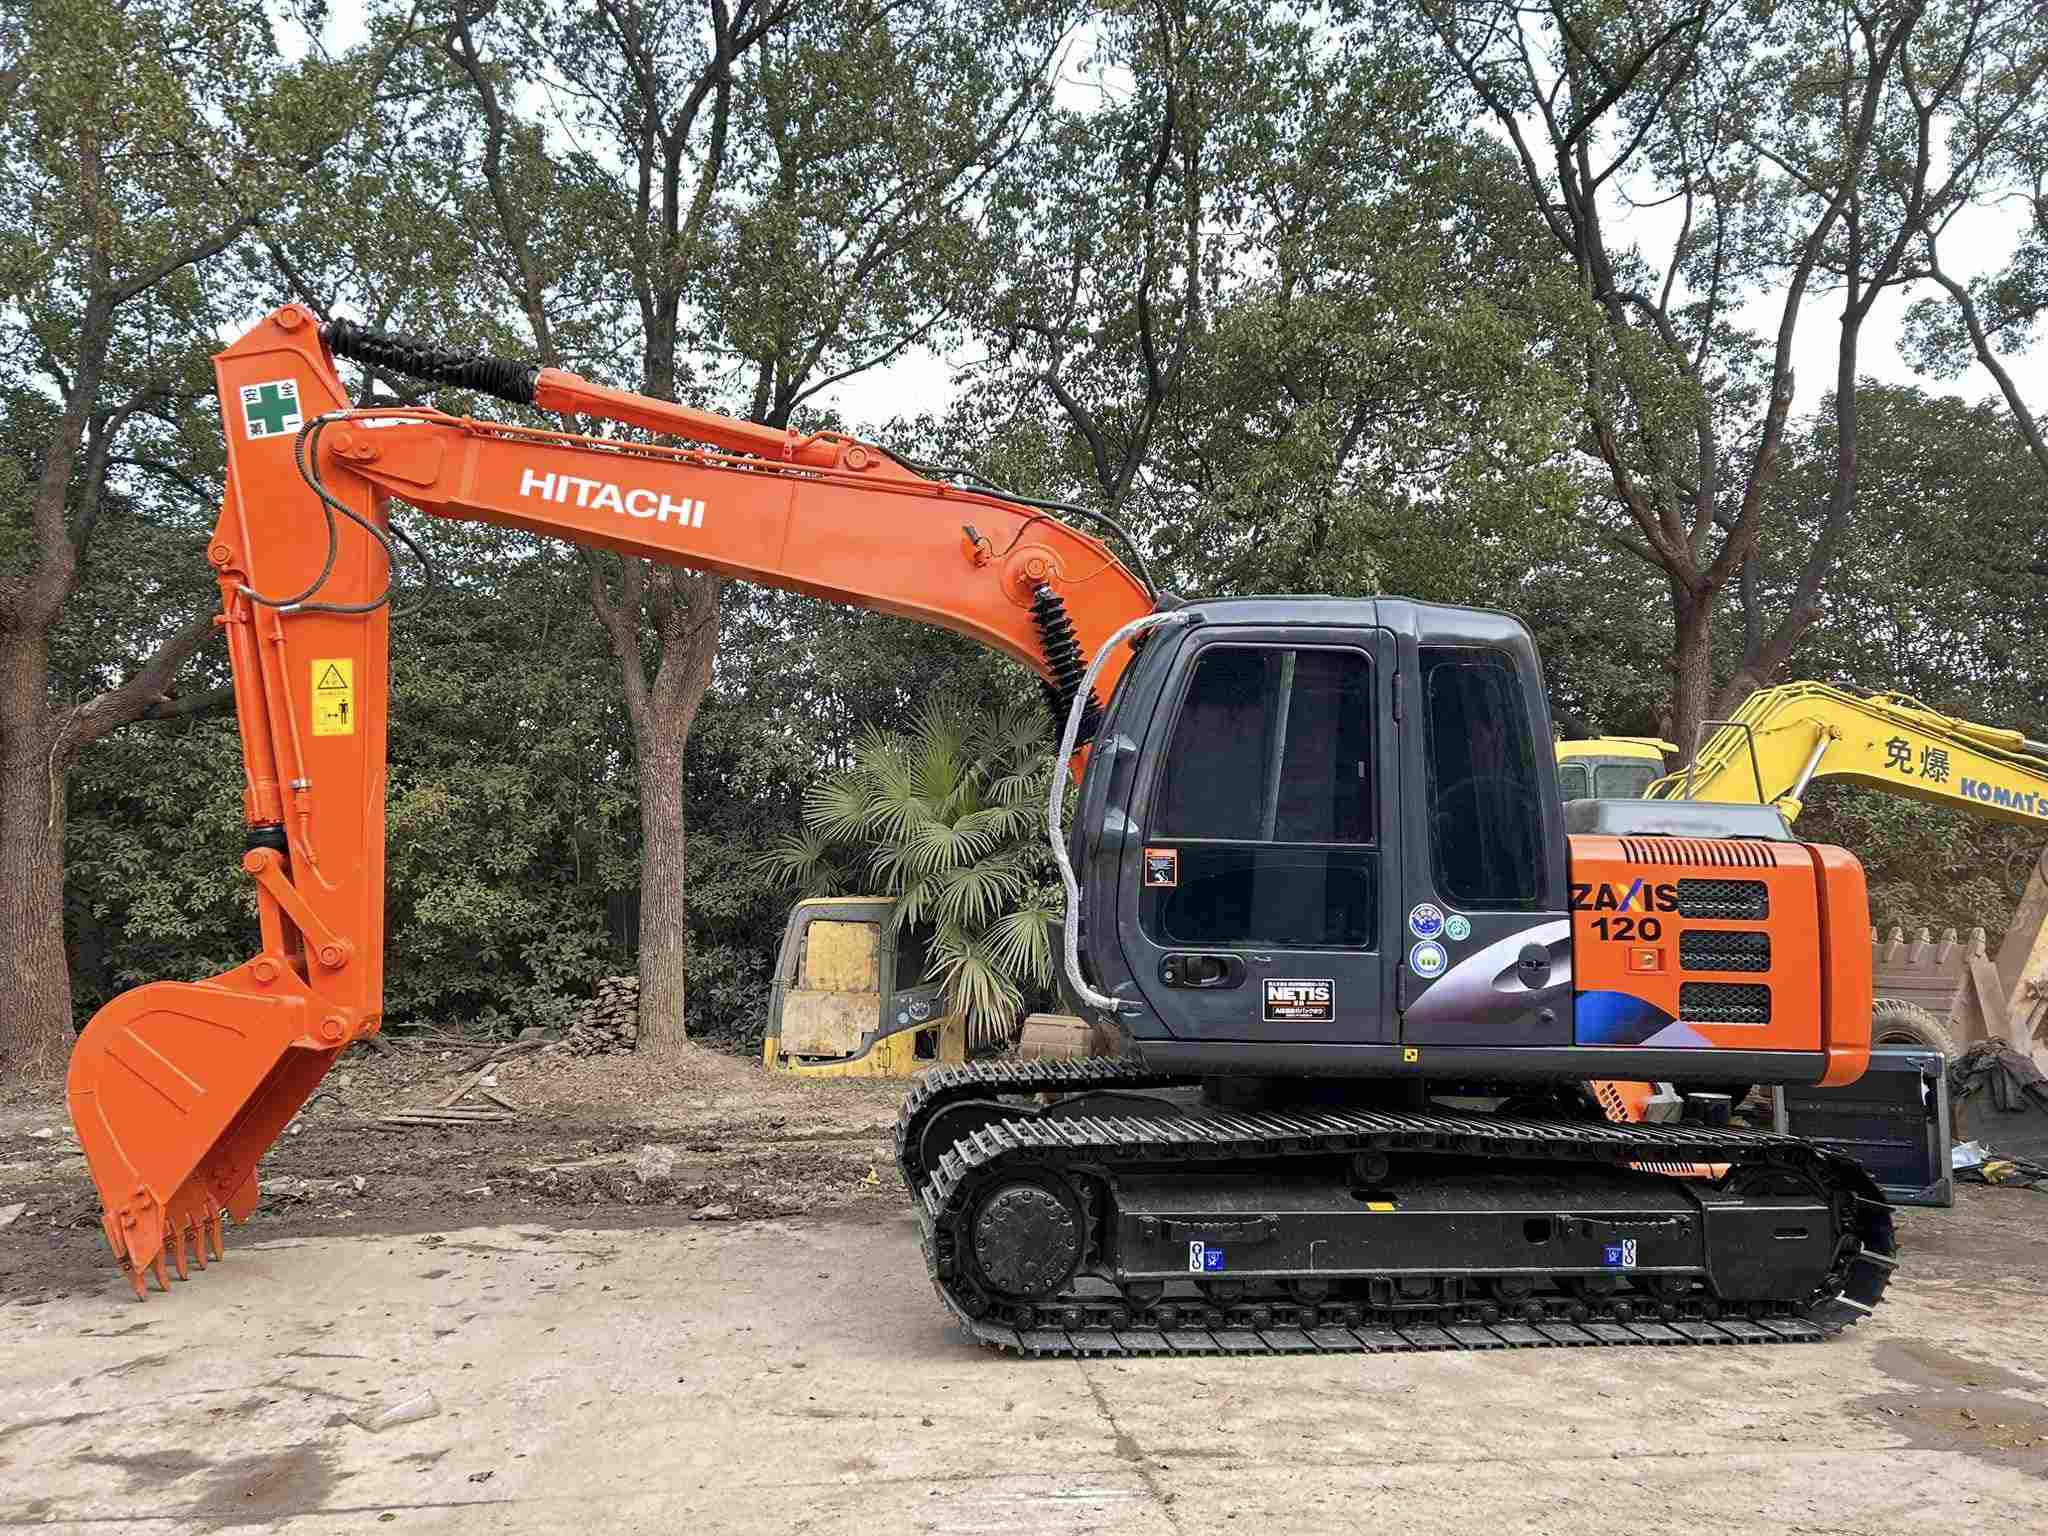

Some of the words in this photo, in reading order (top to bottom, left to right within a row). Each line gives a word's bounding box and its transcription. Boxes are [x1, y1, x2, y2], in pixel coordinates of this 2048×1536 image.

[519, 467, 705, 529] HITACHI
[1884, 735, 1950, 783] 免爆
[1569, 878, 1679, 912] ZAXIS
[1590, 916, 1662, 942] 120
[1267, 987, 1330, 1001] NETIS
